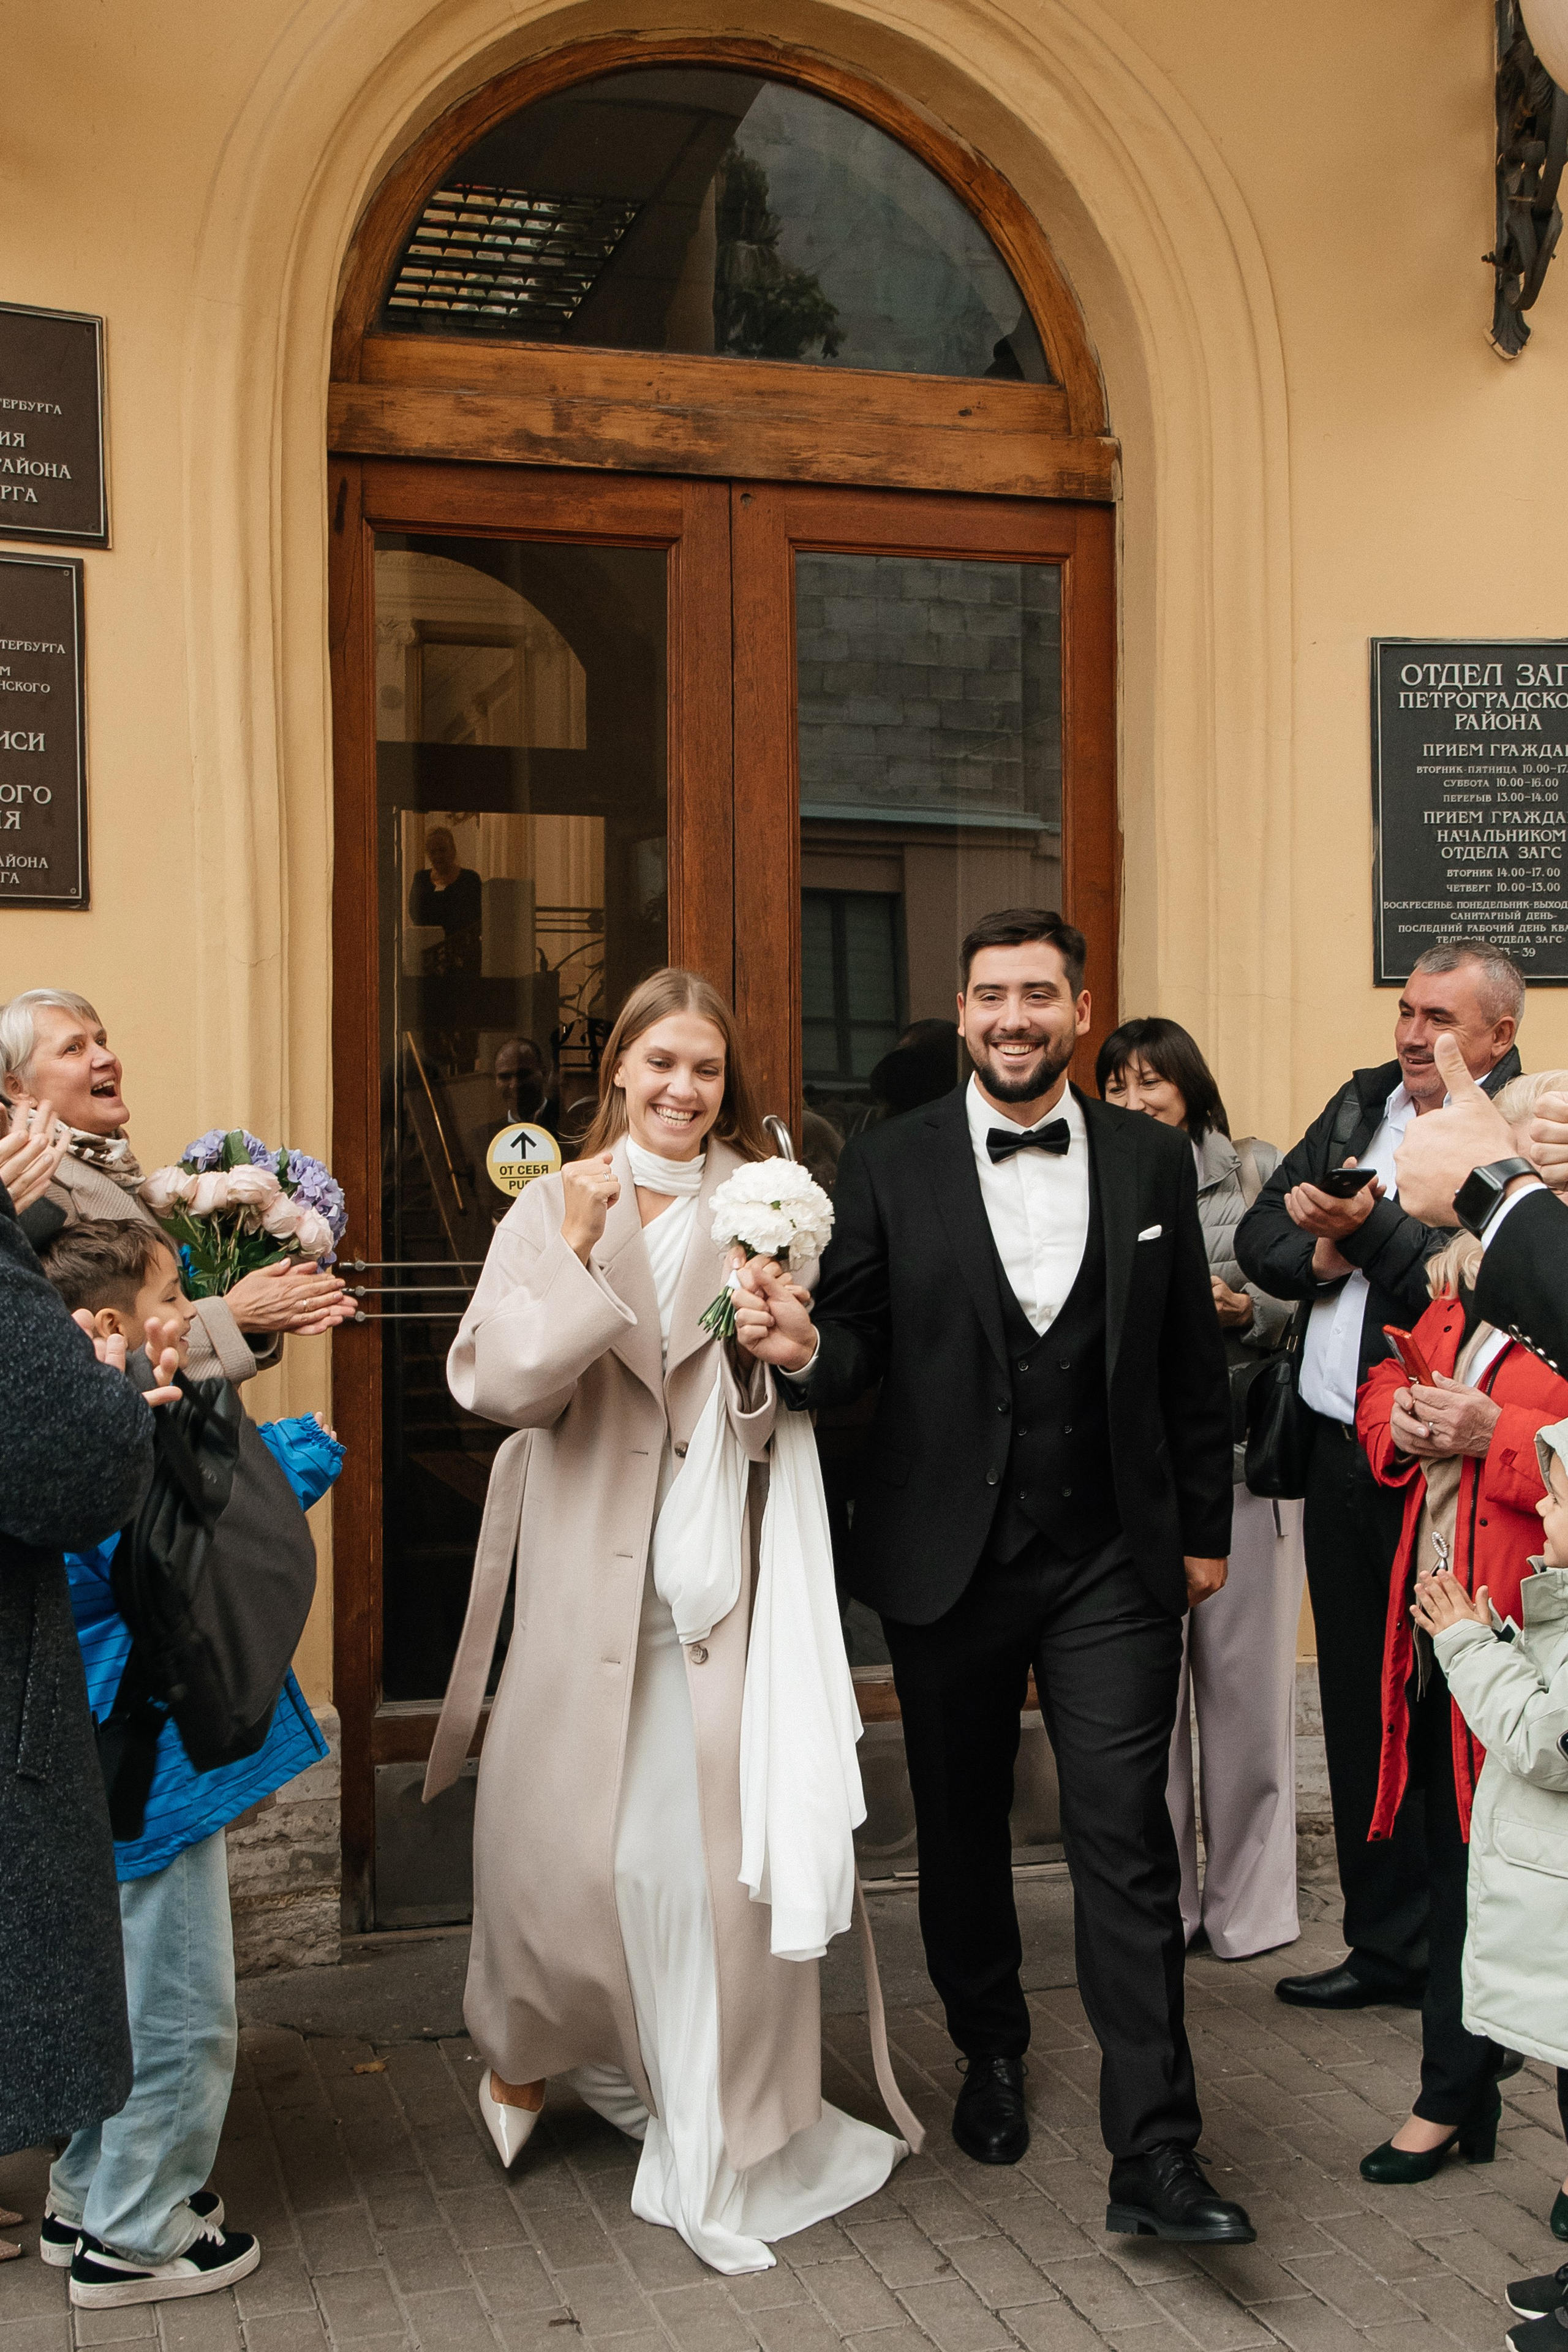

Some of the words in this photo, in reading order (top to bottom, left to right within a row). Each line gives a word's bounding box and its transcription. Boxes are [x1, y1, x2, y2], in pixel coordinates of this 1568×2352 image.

[0, 457, 72, 480] АЙОНА
[0, 639, 66, 654] ТЕРБУРГА
[1400, 663, 1504, 691] ОТДЕЛ
[1398, 692, 1568, 712] ПЕТРОГРАДСКО
[1454, 709, 1542, 731] РАЙОНА
[1422, 744, 1483, 757] ПРИЕМ
[1490, 744, 1568, 760] ГРАЖДА
[1442, 779, 1490, 788] СУББОТА
[0, 784, 52, 804] ОГО
[1442, 794, 1492, 802] ПЕРЕРЫВ
[1423, 810, 1483, 824] ПРИЕМ
[1436, 829, 1567, 843] НАЧАЛЬНИКОМ
[1441, 846, 1510, 862] ОТДЕЛА
[1518, 846, 1562, 859] ЗАГС
[1446, 869, 1493, 878] ВТОРНИК
[1446, 884, 1492, 892] ЧЕТВЕРГ
[1450, 910, 1521, 920] САНИТАРНЫЙ
[1398, 922, 1463, 933] ПОСЛЕДНИЙ
[1466, 922, 1515, 933] РАБОЧИЙ
[1518, 924, 1547, 933] ДЕНЬ
[1489, 935, 1531, 944] ОТДЕЛА
[499, 1165, 514, 1175] ОТ
[517, 1164, 549, 1175] СЕБЯ
[508, 1180, 532, 1190] PU
